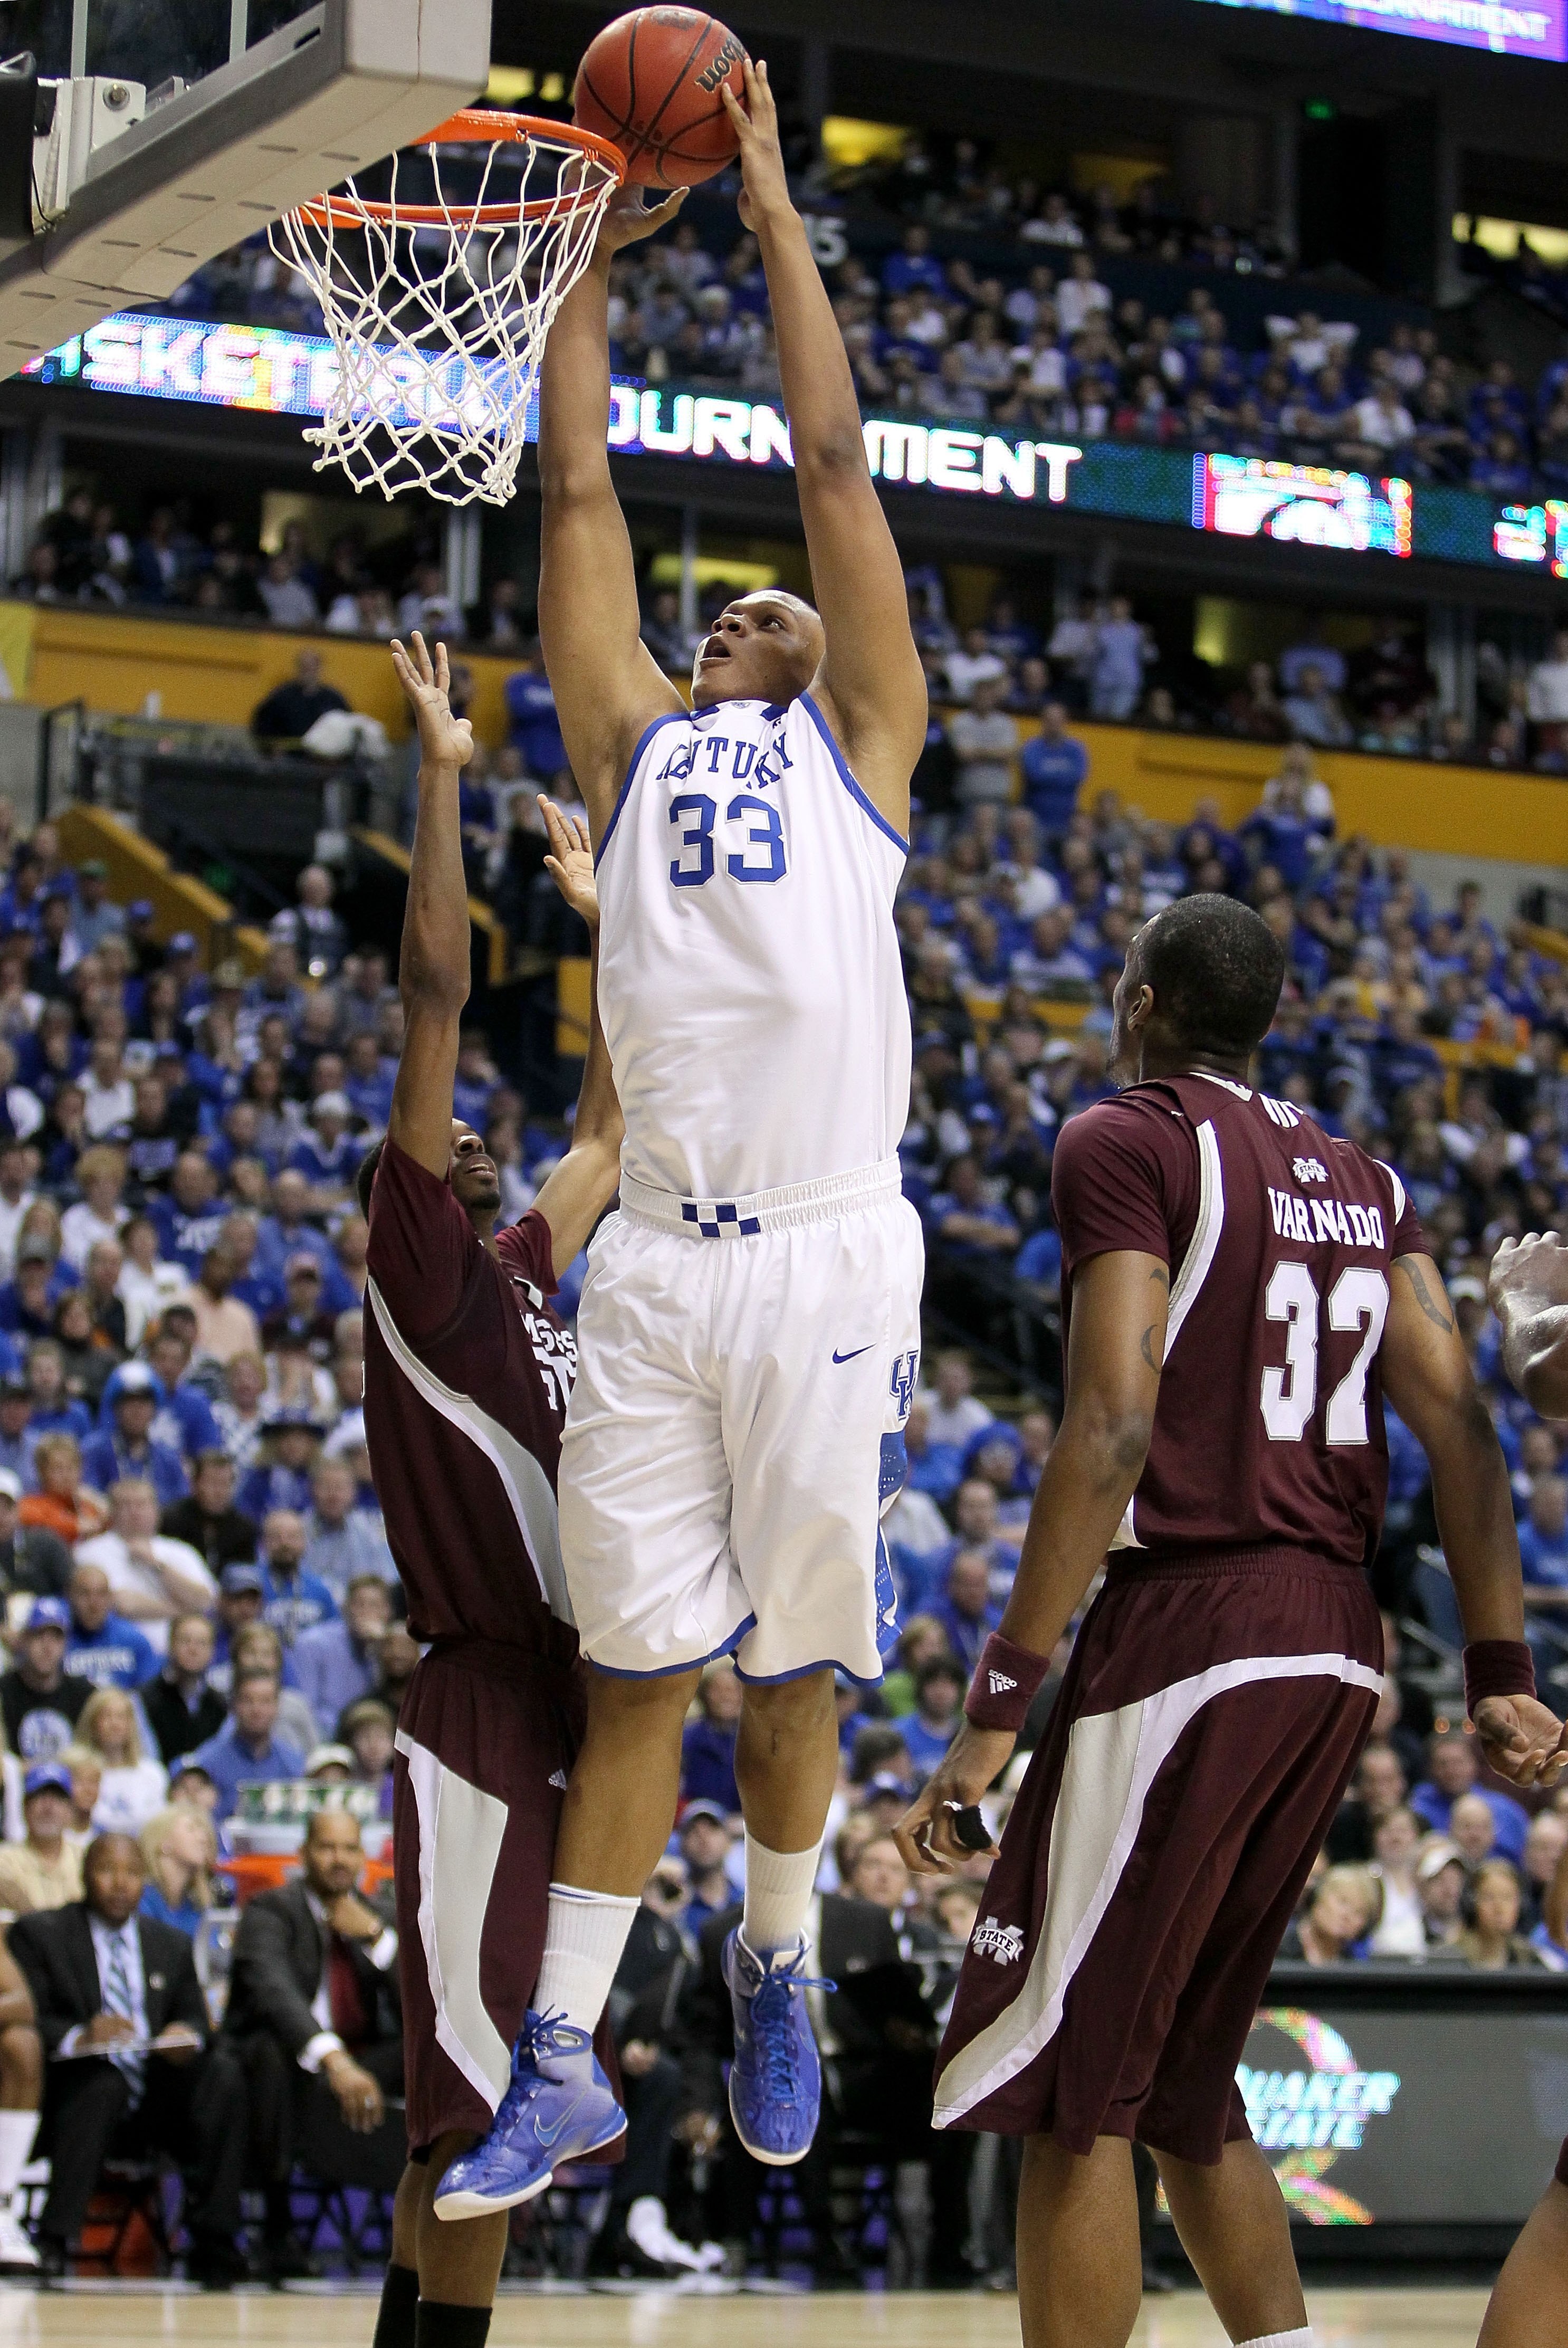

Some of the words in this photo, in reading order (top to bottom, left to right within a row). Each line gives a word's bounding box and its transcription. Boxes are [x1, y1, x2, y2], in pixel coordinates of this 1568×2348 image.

[668, 793, 788, 888] 33
[1267, 1186, 1385, 1249] VARNADO
[1260, 1260, 1390, 1446] 32
[979, 1929, 1014, 1952] STATE
